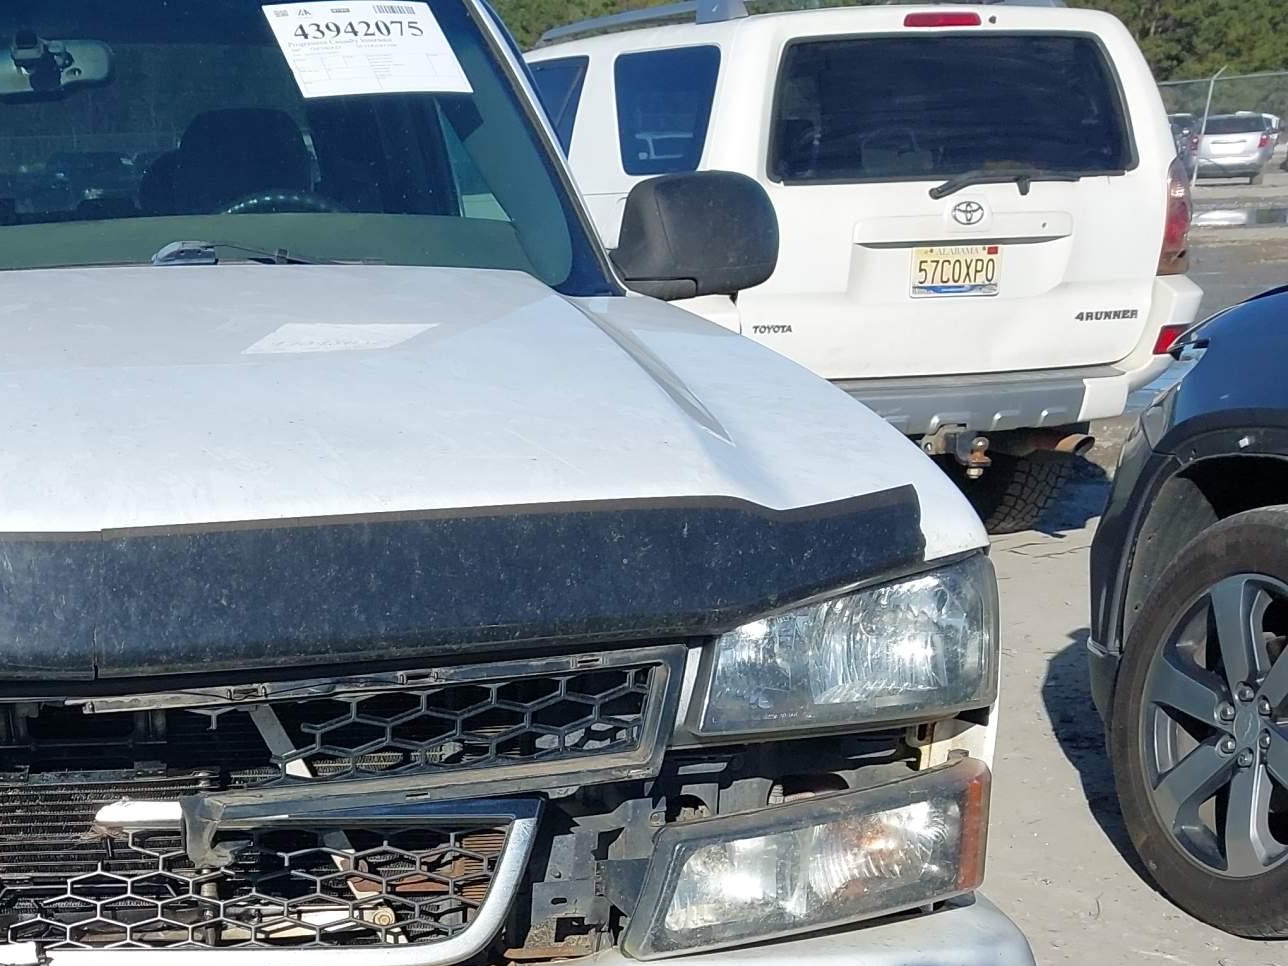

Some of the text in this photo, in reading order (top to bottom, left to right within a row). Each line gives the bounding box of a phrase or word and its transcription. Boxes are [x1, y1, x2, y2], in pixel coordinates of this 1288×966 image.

[294, 20, 423, 39] 43942075
[1075, 309, 1139, 321] 4RUNNER
[752, 325, 792, 334] TOYOTA
